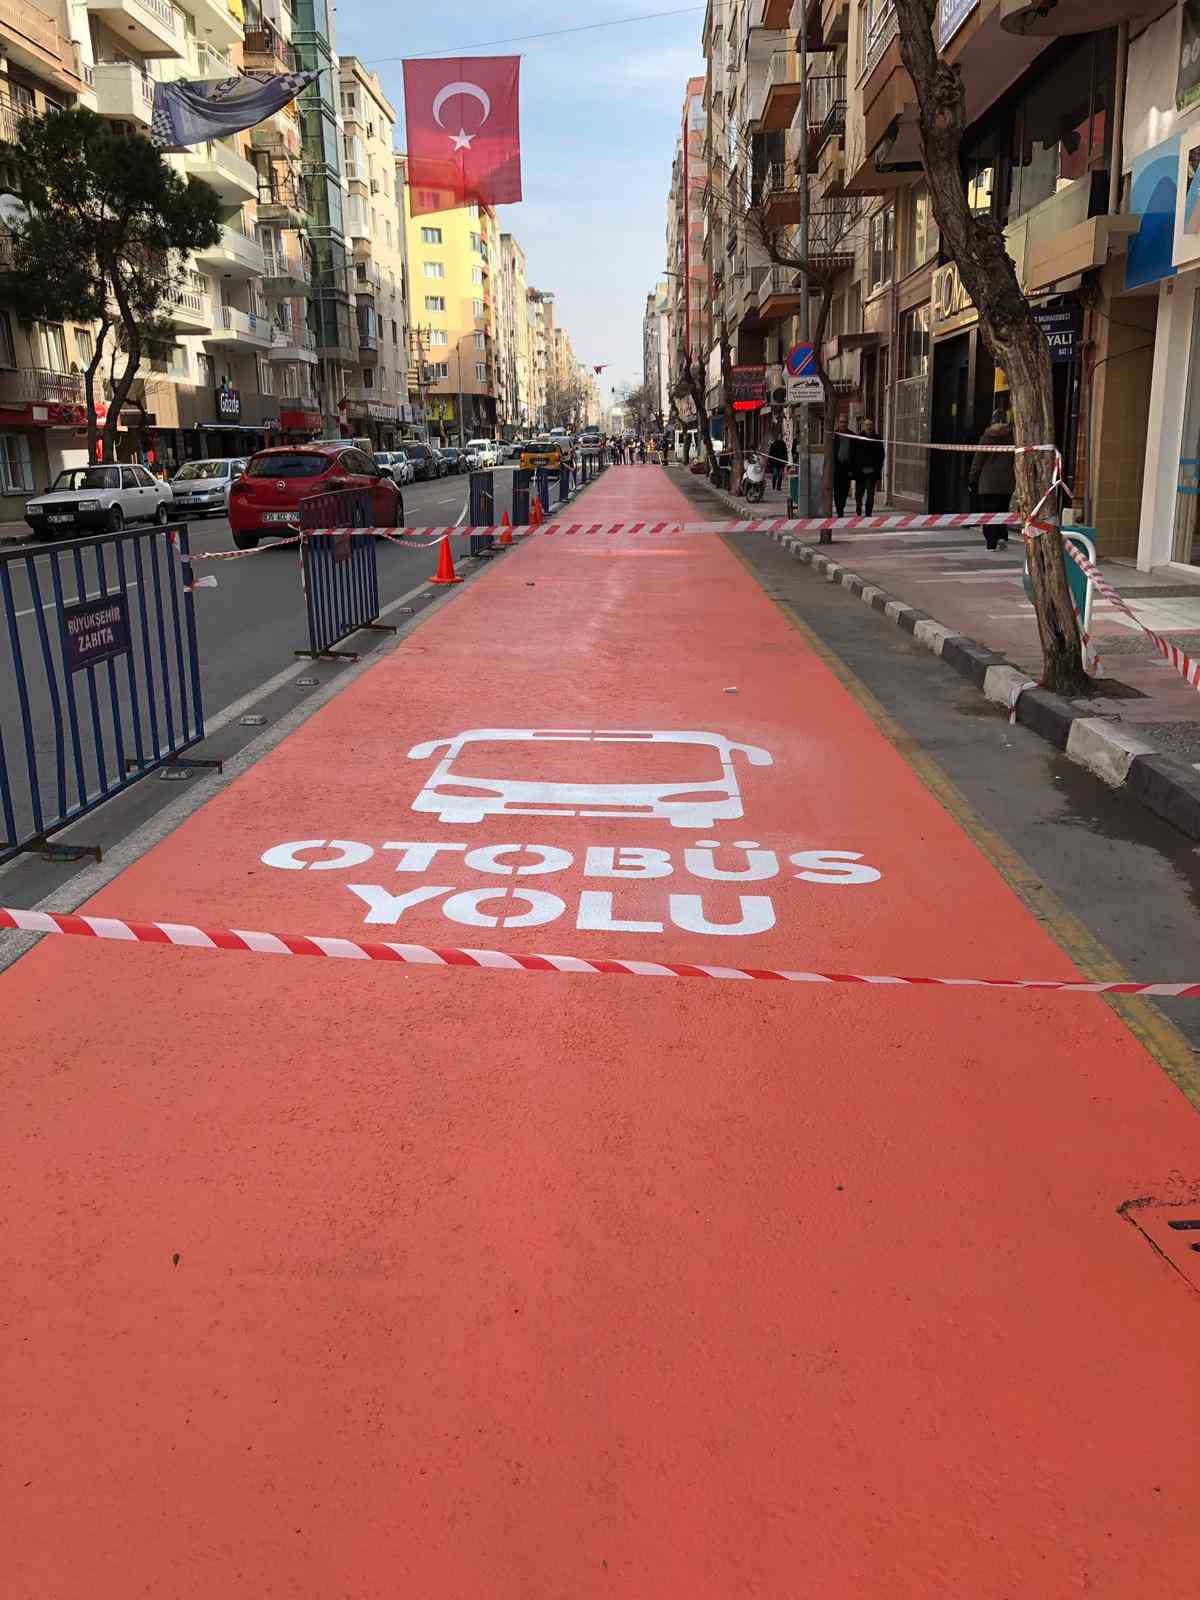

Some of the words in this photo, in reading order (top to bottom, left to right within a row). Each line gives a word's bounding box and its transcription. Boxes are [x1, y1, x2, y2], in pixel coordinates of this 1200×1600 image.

[78, 629, 114, 652] ZABITA
[261, 839, 882, 885] OTOBÜS
[347, 884, 777, 936] YOLU
